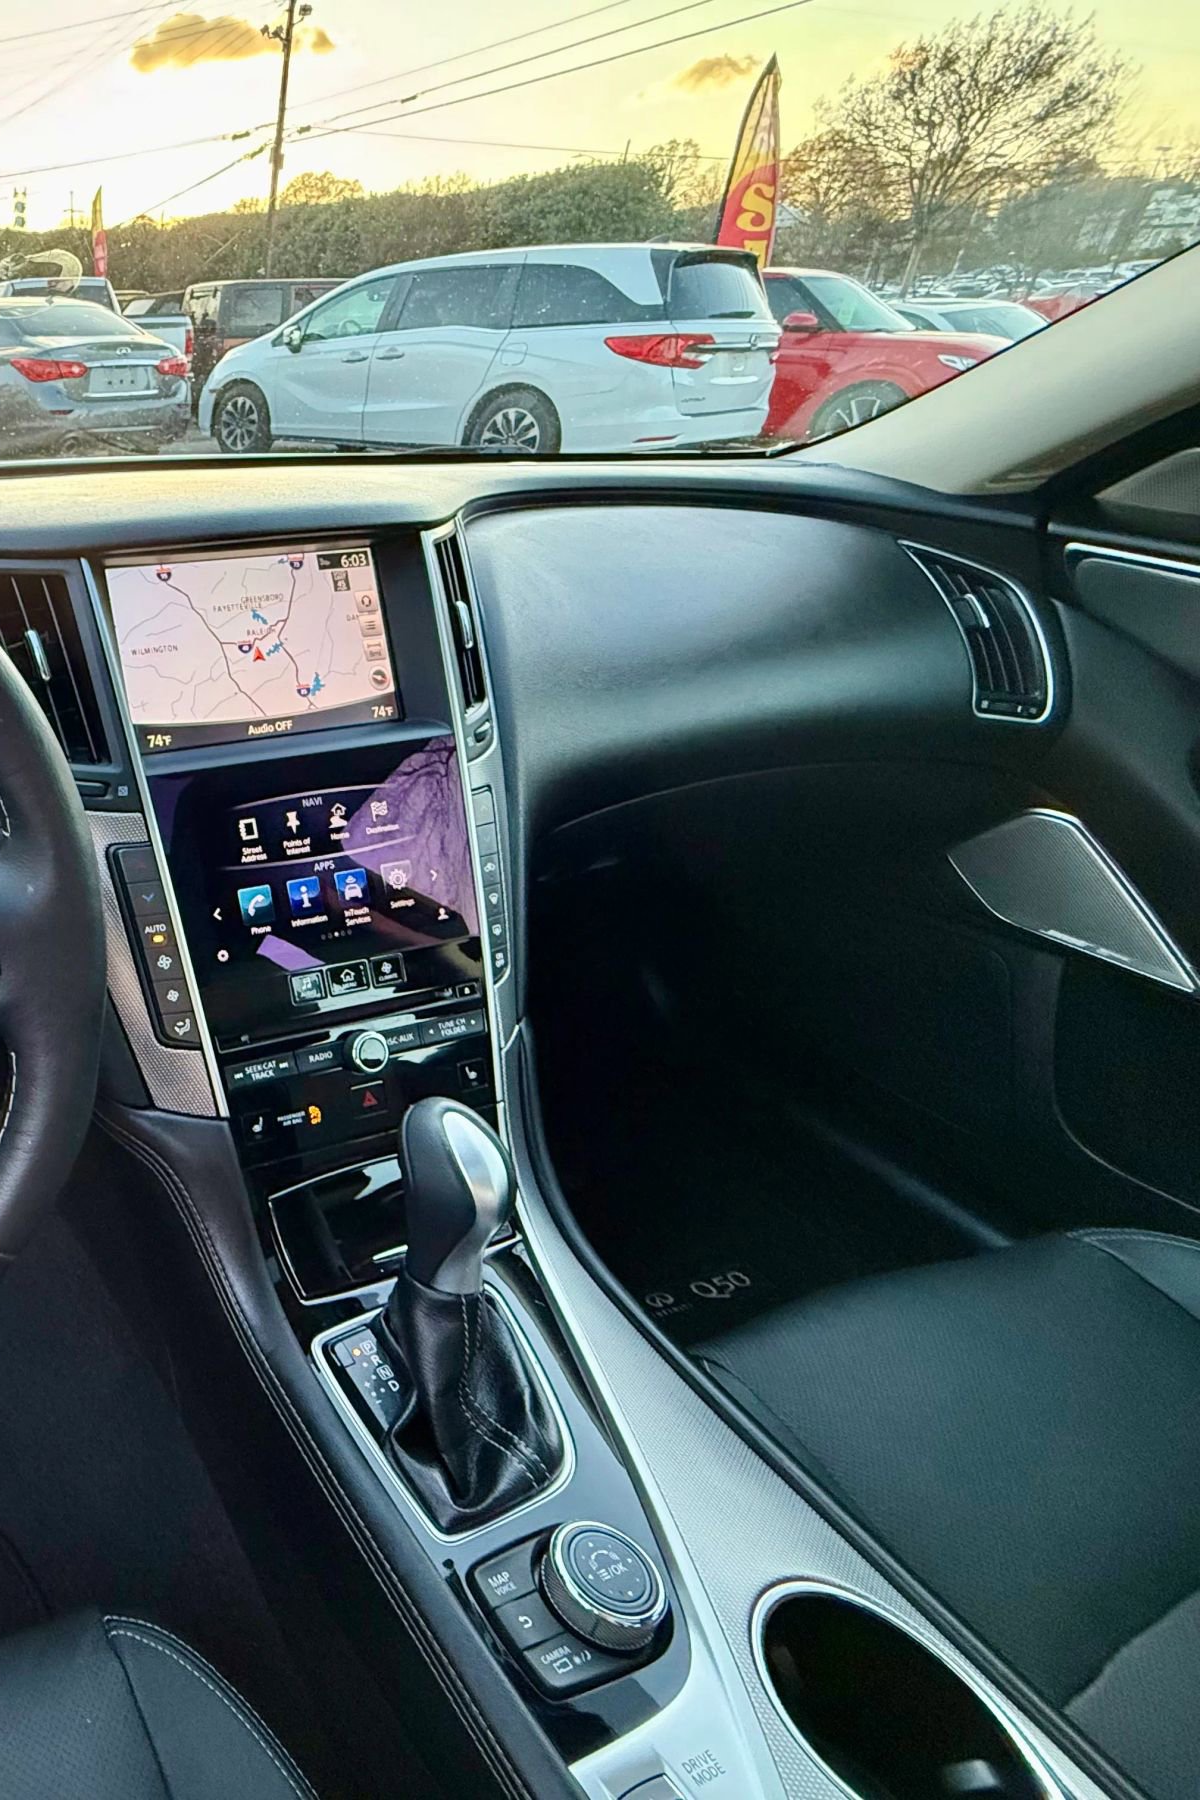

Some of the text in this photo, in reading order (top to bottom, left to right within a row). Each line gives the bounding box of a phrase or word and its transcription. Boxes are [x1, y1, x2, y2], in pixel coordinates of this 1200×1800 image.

[340, 553, 367, 568] 6:03
[240, 593, 284, 604] GREENSBORO
[212, 602, 262, 612] FAYETTEVILLE
[246, 628, 276, 636] RALEIGH
[131, 645, 178, 656] WILMINGTON
[247, 720, 293, 736] Audio OFF
[302, 797, 323, 808] NAVI
[330, 832, 350, 841] Home
[283, 838, 311, 849] Points of
[241, 853, 268, 864] Address
[313, 861, 336, 873] APPS
[291, 915, 329, 927] Information
[345, 915, 372, 927] Services
[144, 923, 167, 934] AUTO
[251, 926, 272, 935] Phone
[440, 1025, 467, 1036] FOLDER
[308, 1051, 333, 1063] RADIO
[251, 1069, 275, 1081] TRACK
[689, 1271, 751, 1299] Q50
[370, 1355, 383, 1367] R
[388, 1380, 400, 1392] D
[488, 1571, 511, 1588] MAP
[494, 1582, 517, 1596] VOICE
[541, 1646, 572, 1665] CAMERA
[681, 1749, 717, 1775] DRIVE
[691, 1762, 726, 1786] MODE
